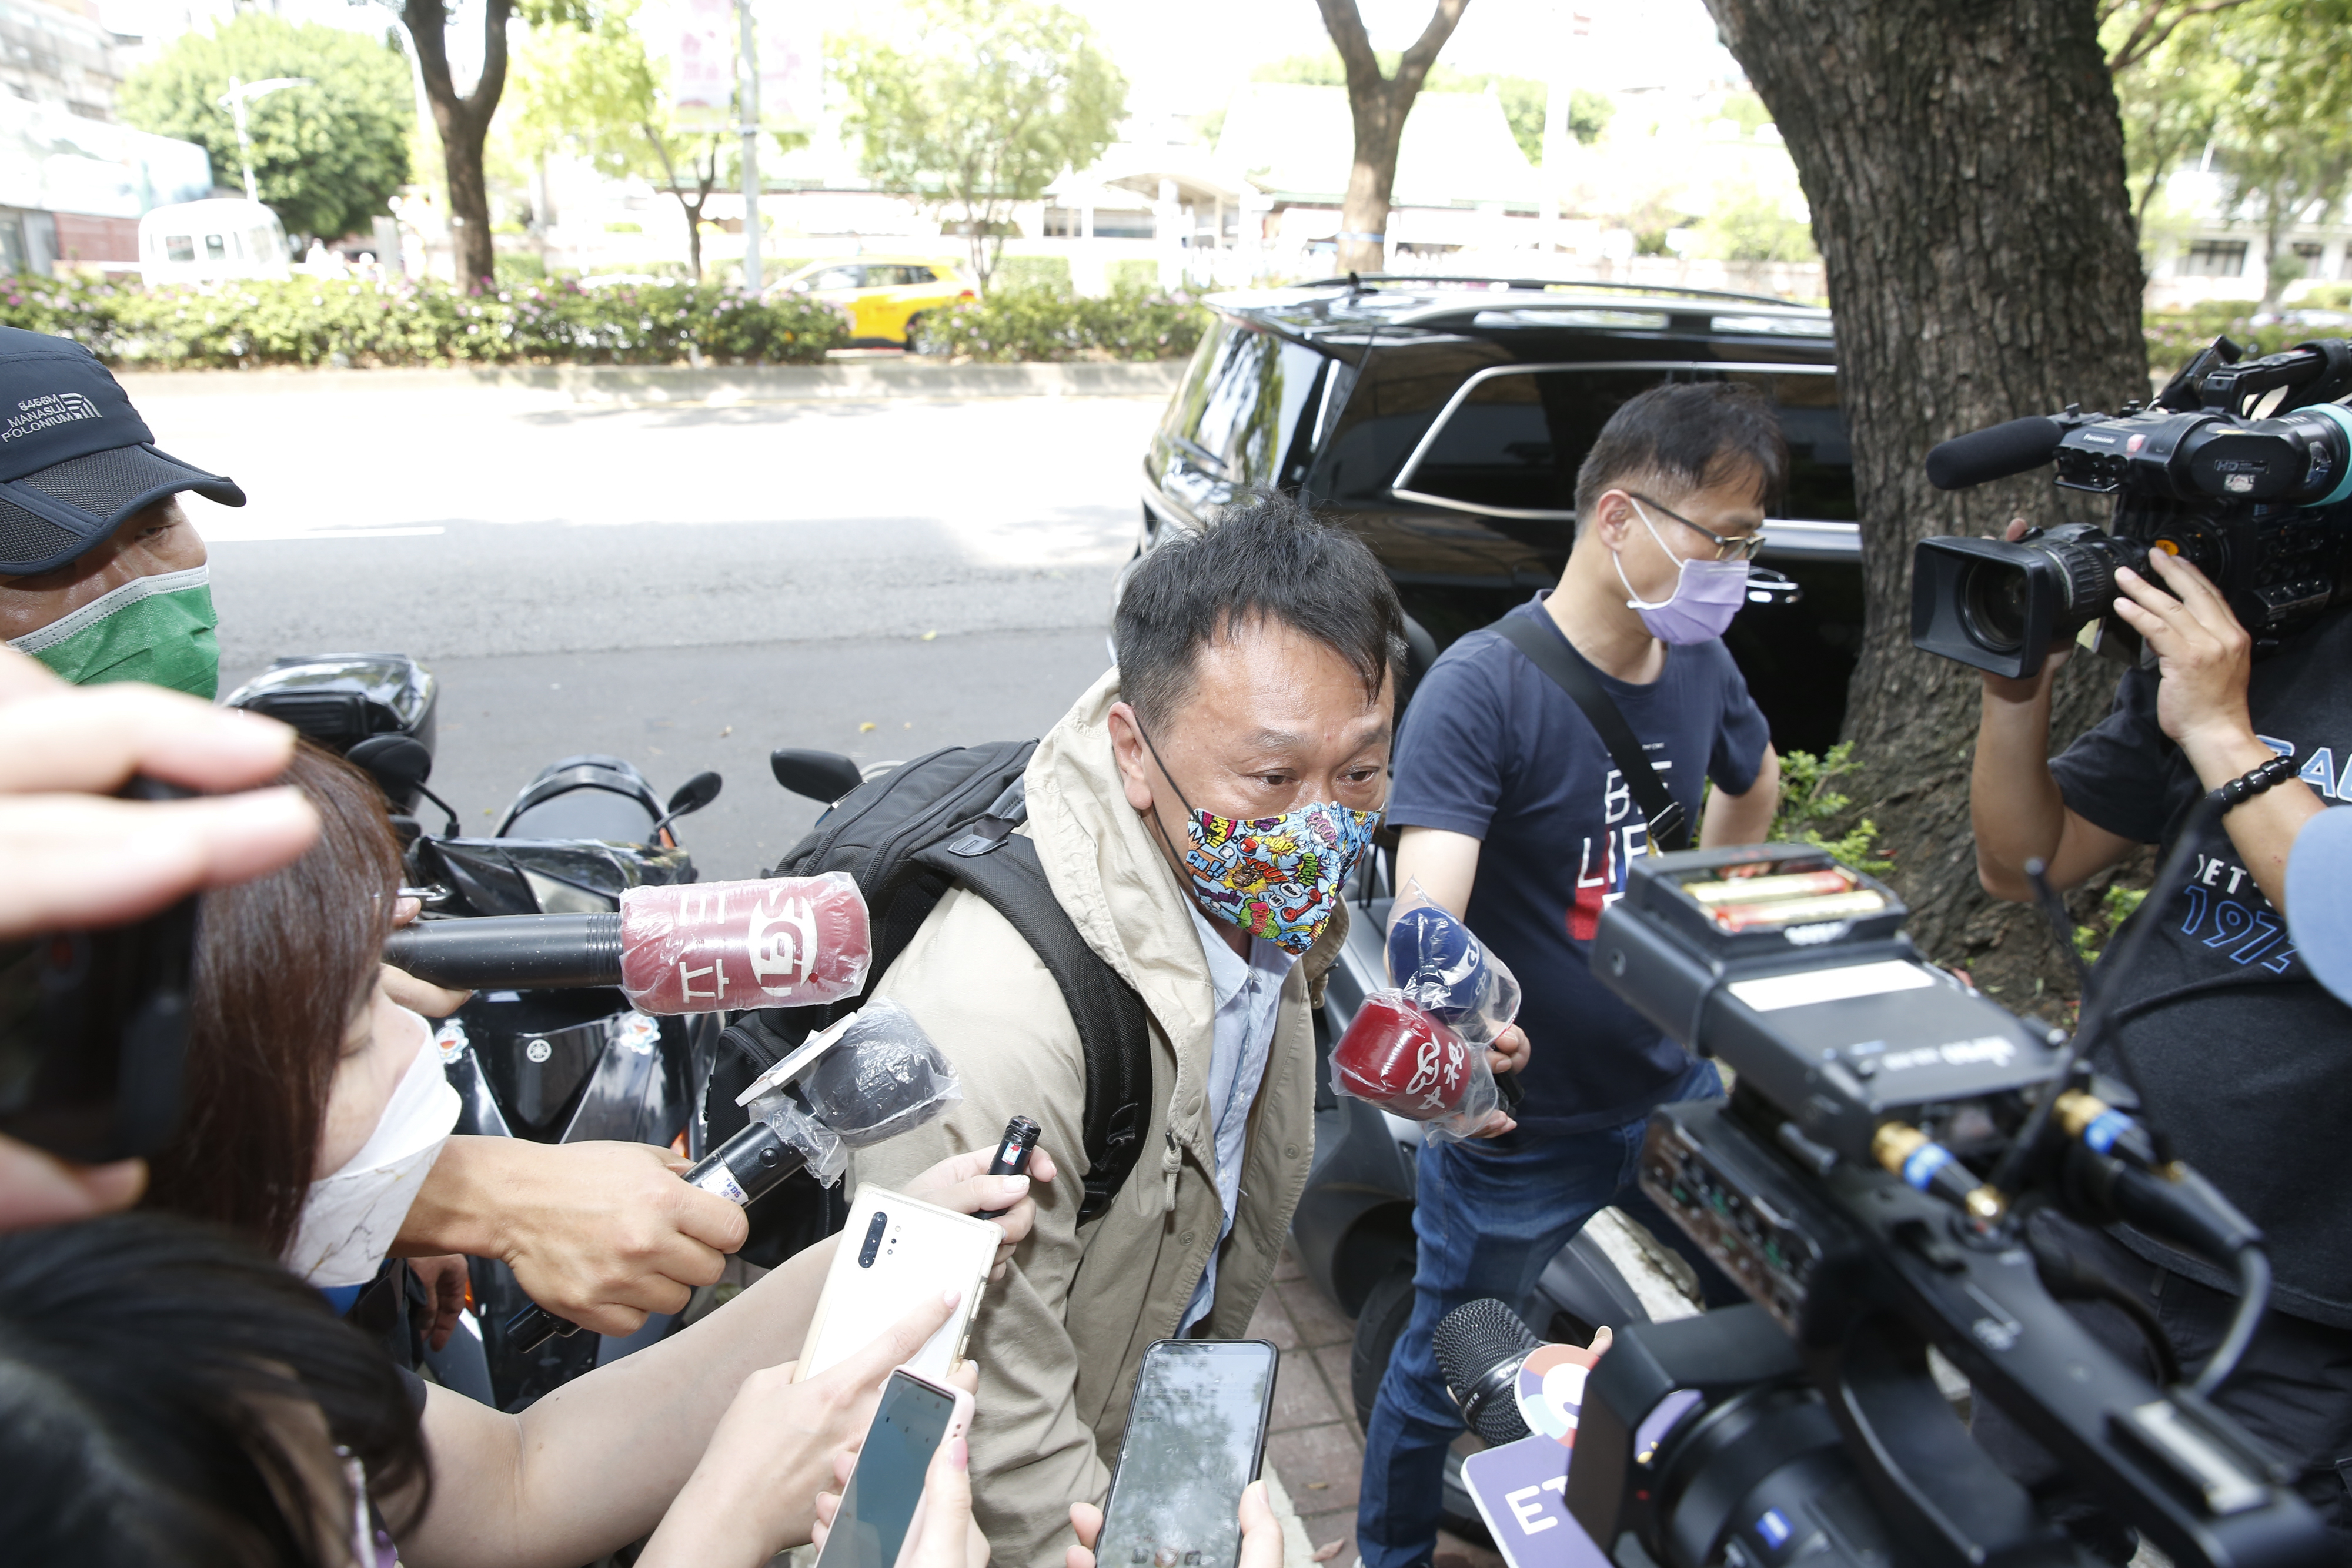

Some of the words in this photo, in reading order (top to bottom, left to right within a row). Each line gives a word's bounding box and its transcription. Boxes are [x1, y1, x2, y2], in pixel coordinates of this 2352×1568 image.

[7, 402, 66, 428] MANASLU
[18, 393, 61, 411] 8456M
[1, 412, 74, 442] POLONIUM
[2083, 433, 2116, 444] Panasonic
[1243, 857, 1289, 883] YOU!
[679, 892, 729, 1004] 三立
[726, 1177, 741, 1198] TVBS
